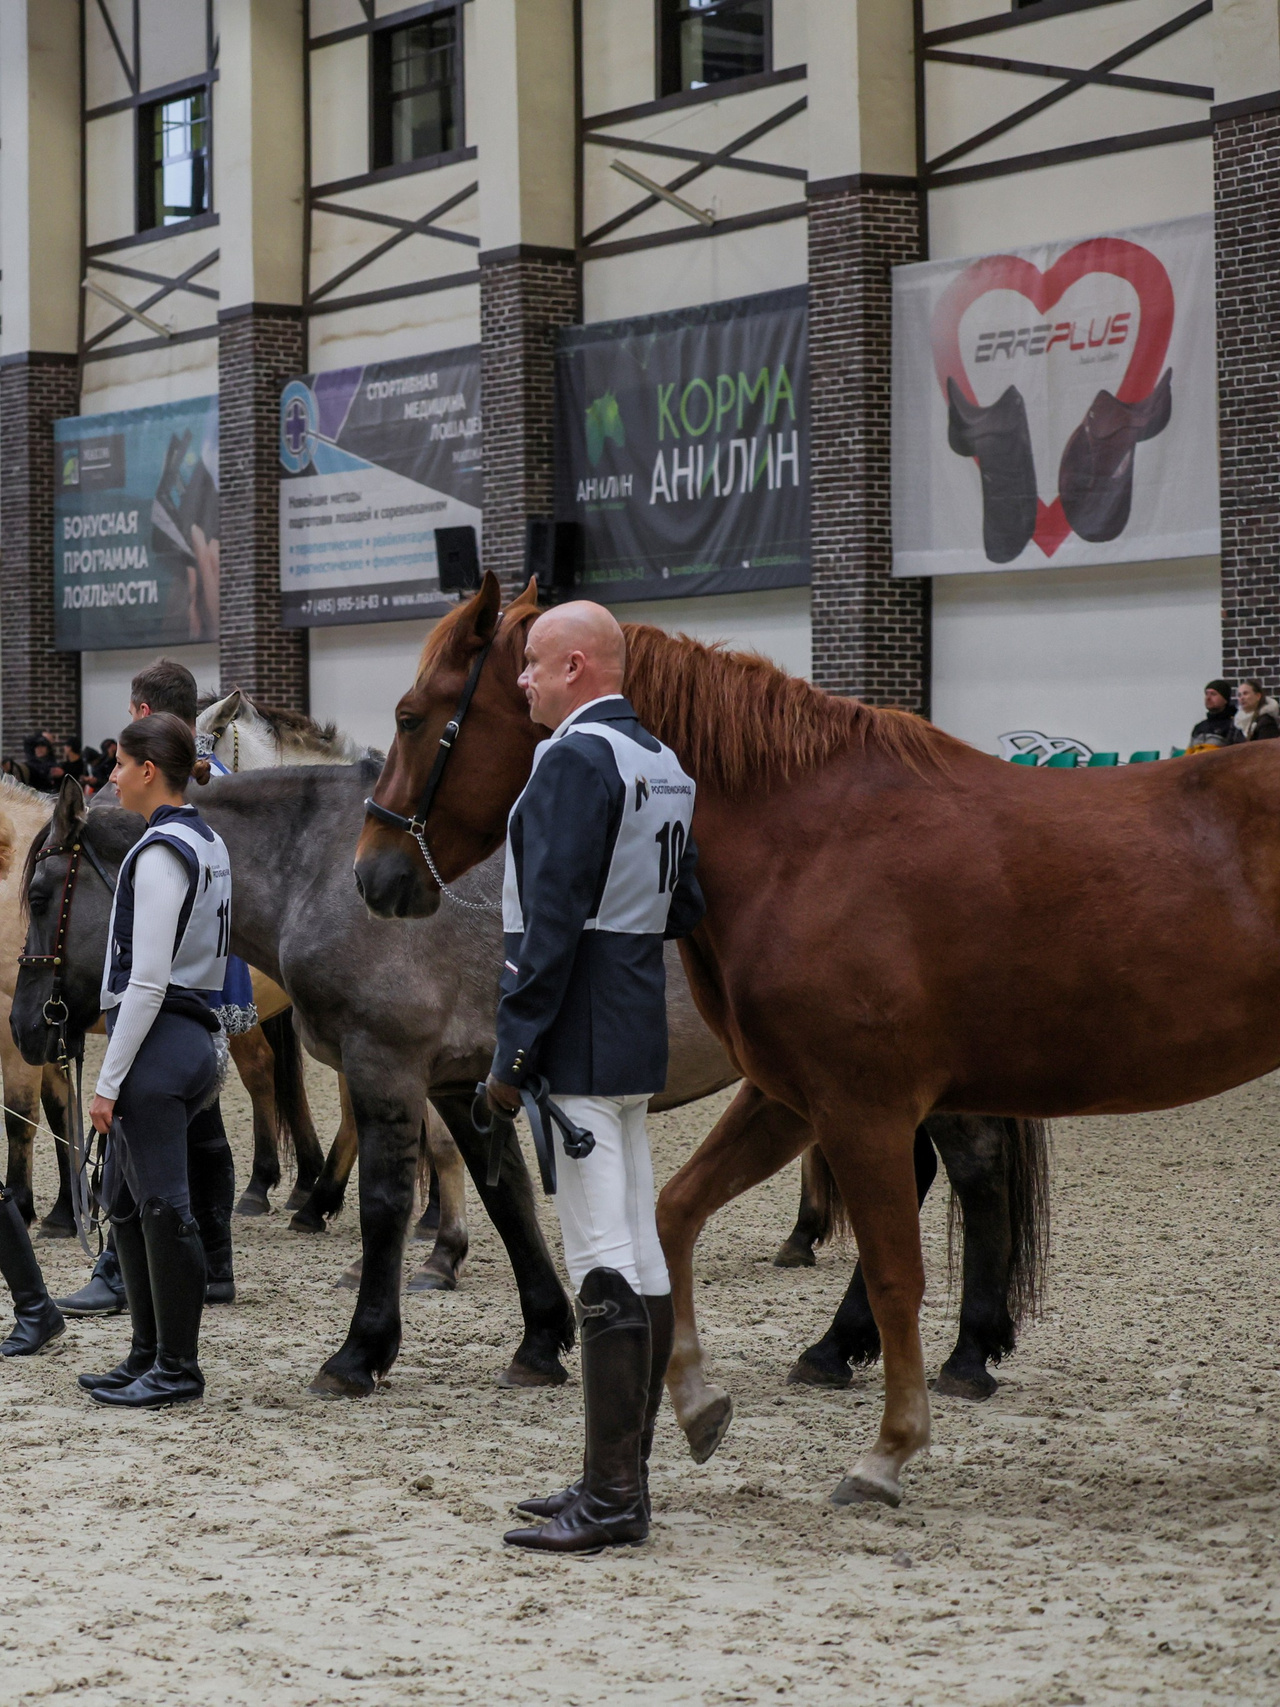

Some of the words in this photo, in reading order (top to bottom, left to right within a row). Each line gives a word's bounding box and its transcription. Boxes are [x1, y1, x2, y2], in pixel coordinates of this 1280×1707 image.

[975, 313, 1132, 363] ERREPLUS
[366, 372, 439, 401] СПОРТИВНАЯ
[403, 392, 467, 421] МЕДИЦИНА
[657, 363, 797, 442] КОРМА
[649, 430, 800, 505] АНИЛИН
[576, 474, 634, 502] АНИЛИН
[62, 510, 139, 540] БОНУСНАЯ
[63, 545, 149, 575] ПРОГРАММА
[62, 580, 159, 609] ЛОЯЛЬНОСТИ
[655, 820, 685, 894] 10
